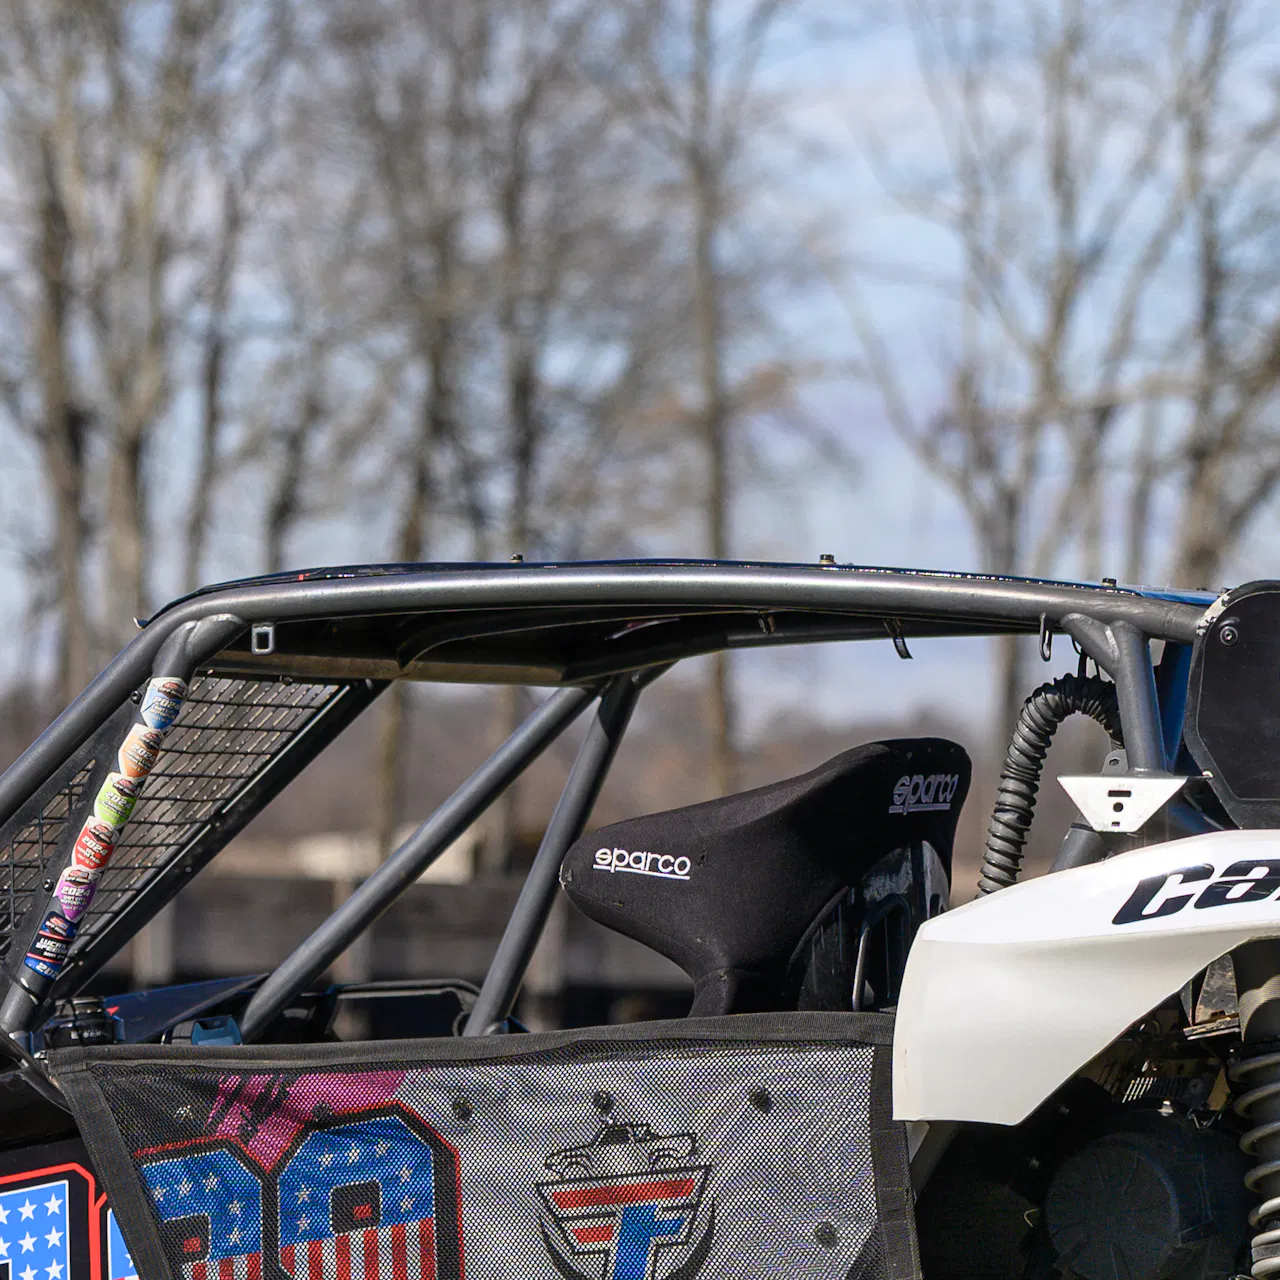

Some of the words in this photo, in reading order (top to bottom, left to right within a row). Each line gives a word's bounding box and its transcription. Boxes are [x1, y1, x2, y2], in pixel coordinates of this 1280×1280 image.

[889, 773, 959, 814] sparco
[80, 835, 109, 856] 2024
[593, 847, 691, 880] sparco
[60, 885, 90, 898] 2024
